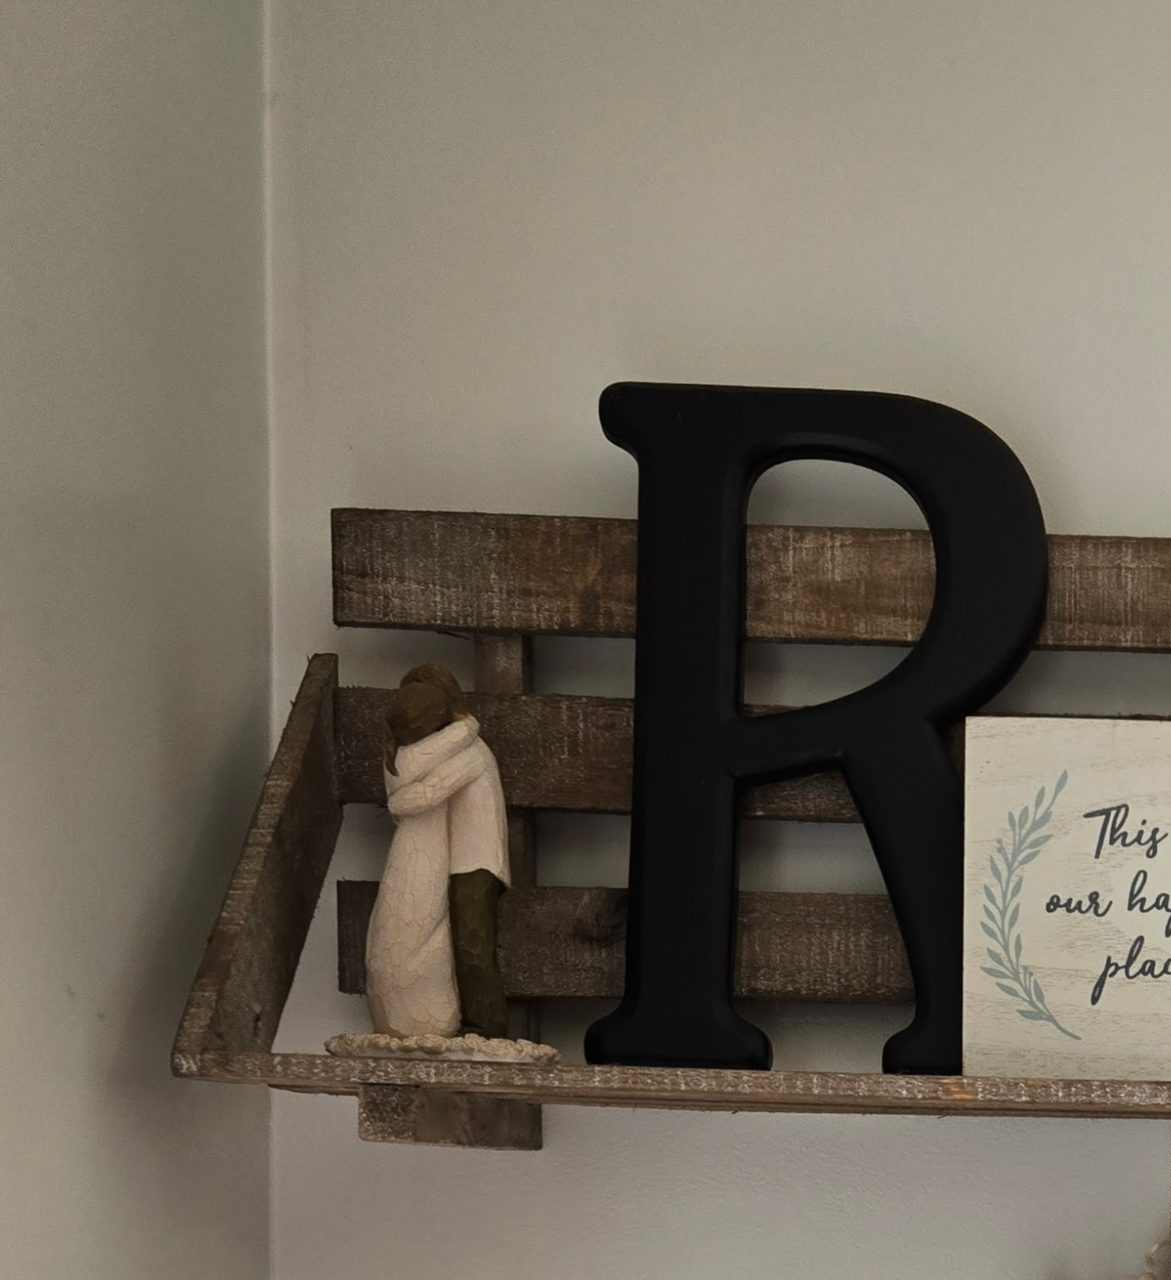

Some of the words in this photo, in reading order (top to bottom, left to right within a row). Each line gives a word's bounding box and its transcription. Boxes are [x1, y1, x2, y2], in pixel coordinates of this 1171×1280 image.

[585, 382, 1047, 1075] R
[1083, 804, 1169, 859] This
[1045, 891, 1113, 917] our
